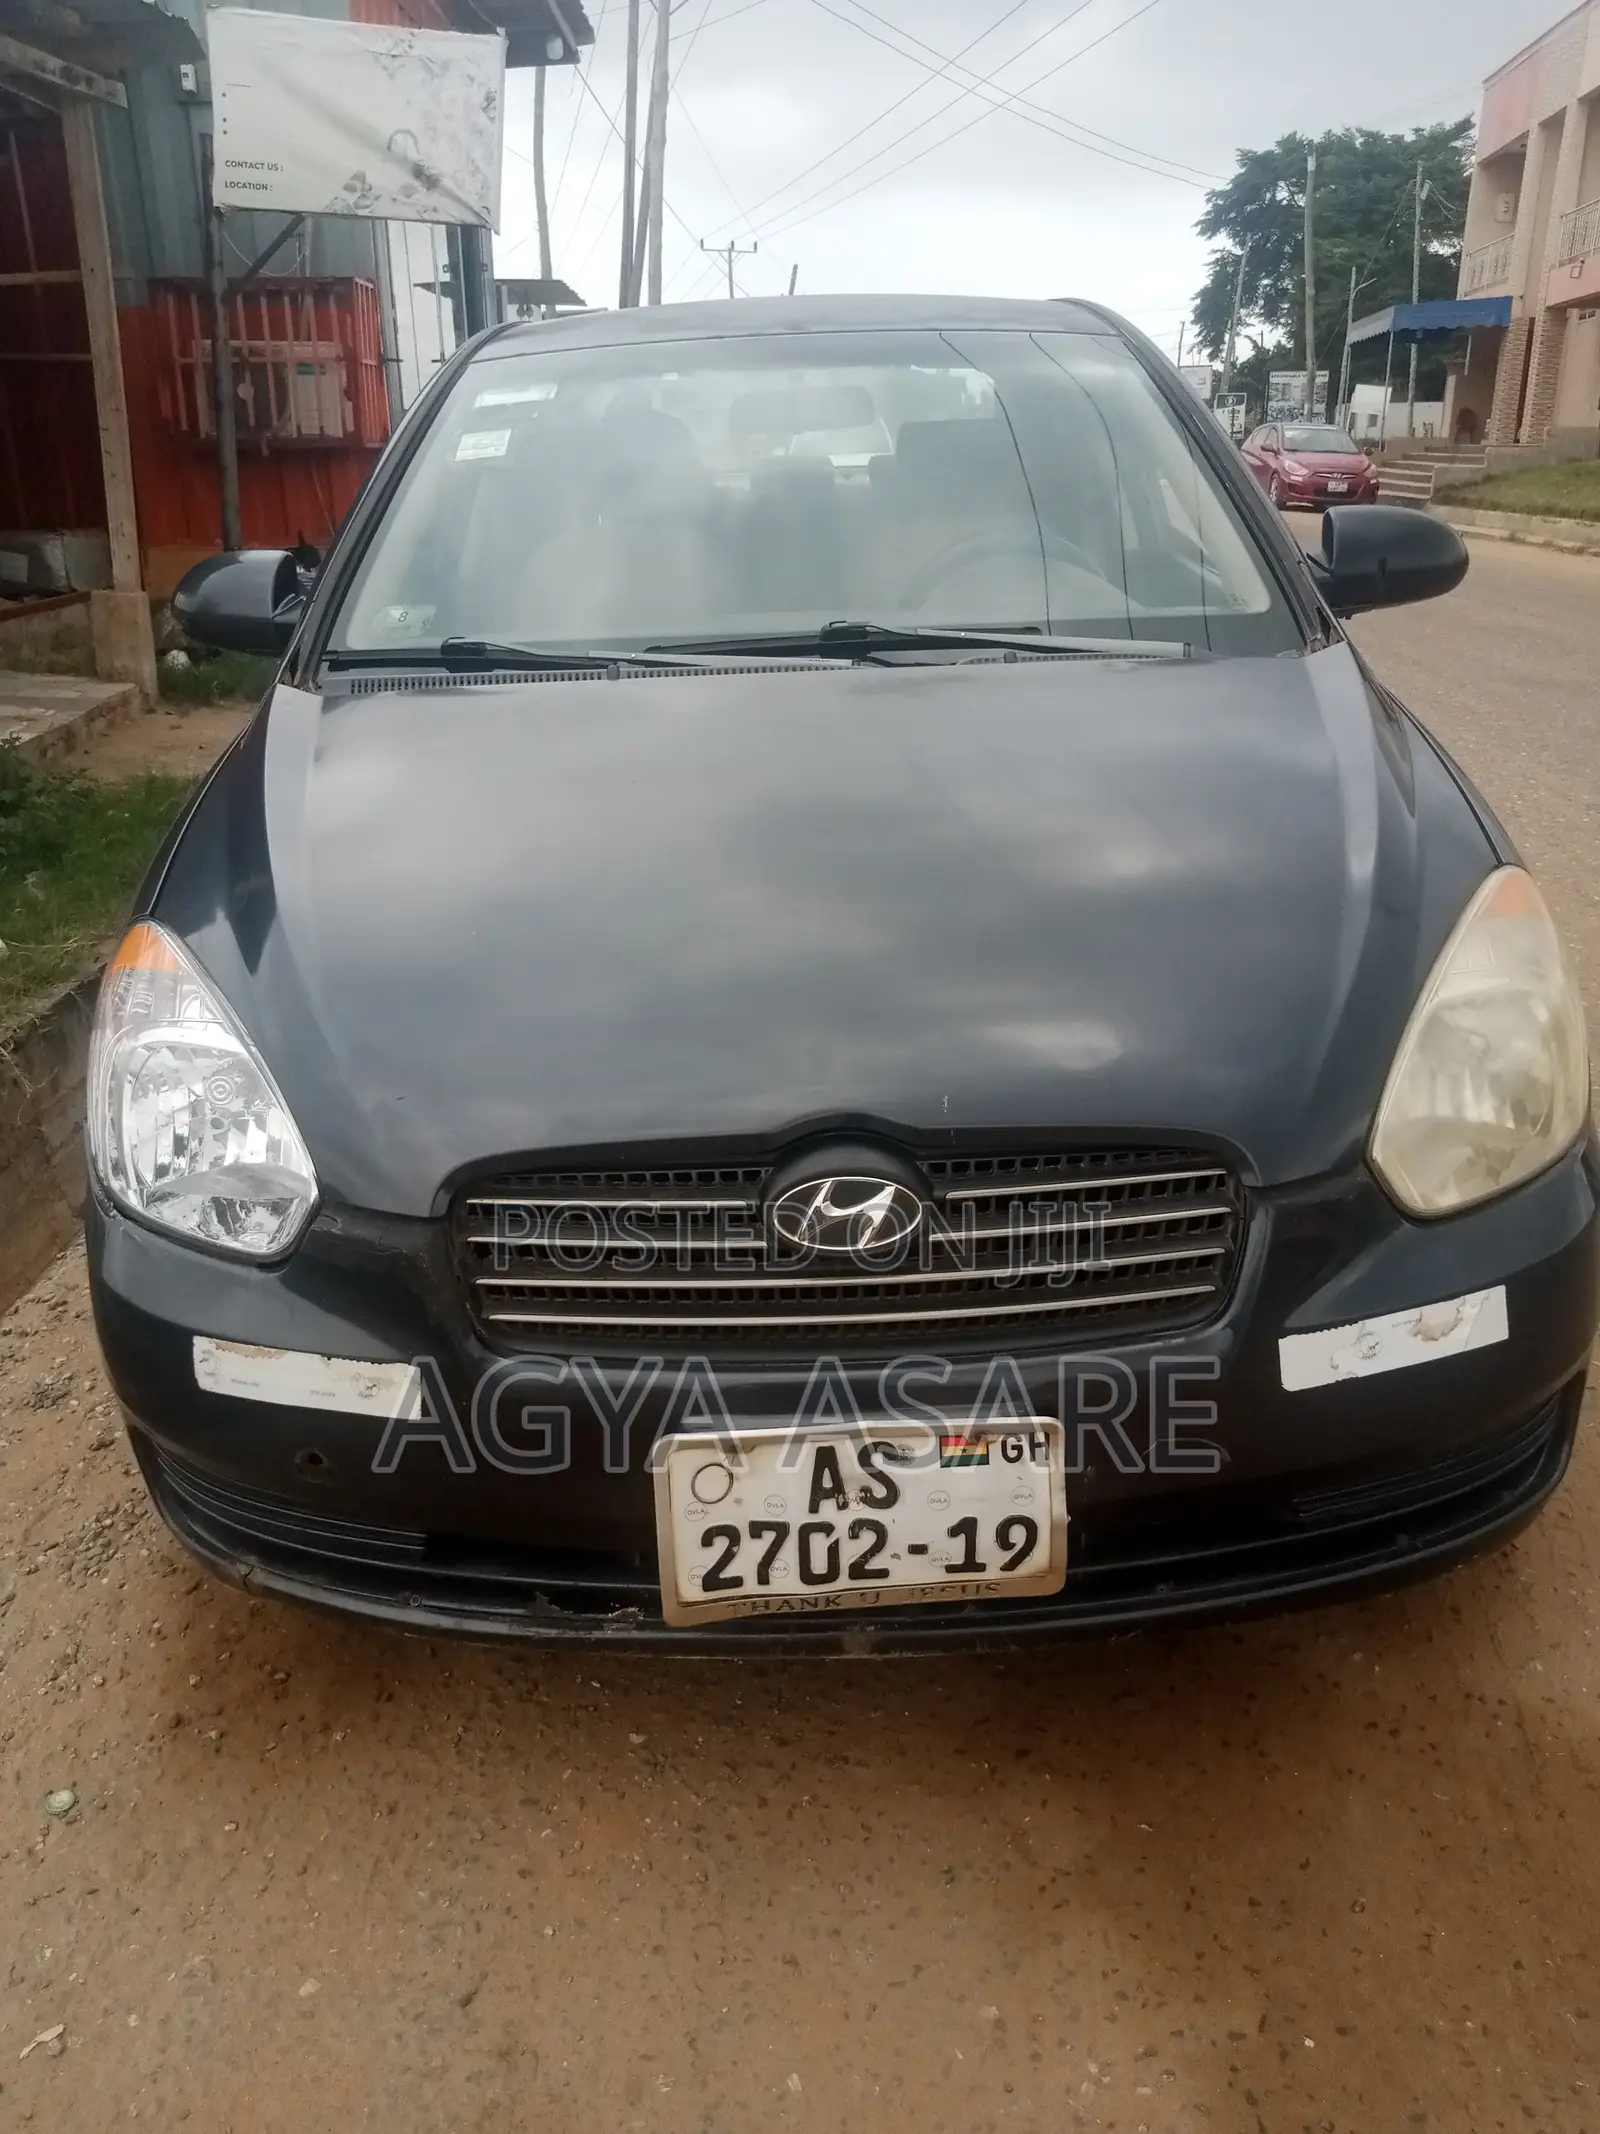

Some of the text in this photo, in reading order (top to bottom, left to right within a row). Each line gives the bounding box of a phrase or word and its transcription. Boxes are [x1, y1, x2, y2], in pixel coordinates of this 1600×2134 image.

[225, 160, 265, 170] CONTACT
[267, 163, 279, 171] US
[224, 180, 268, 191] LOCATION
[1001, 1431, 1050, 1464] GH
[808, 1441, 900, 1513] AS
[700, 1515, 1039, 1592] 2702-19
[727, 1593, 842, 1616] THANK
